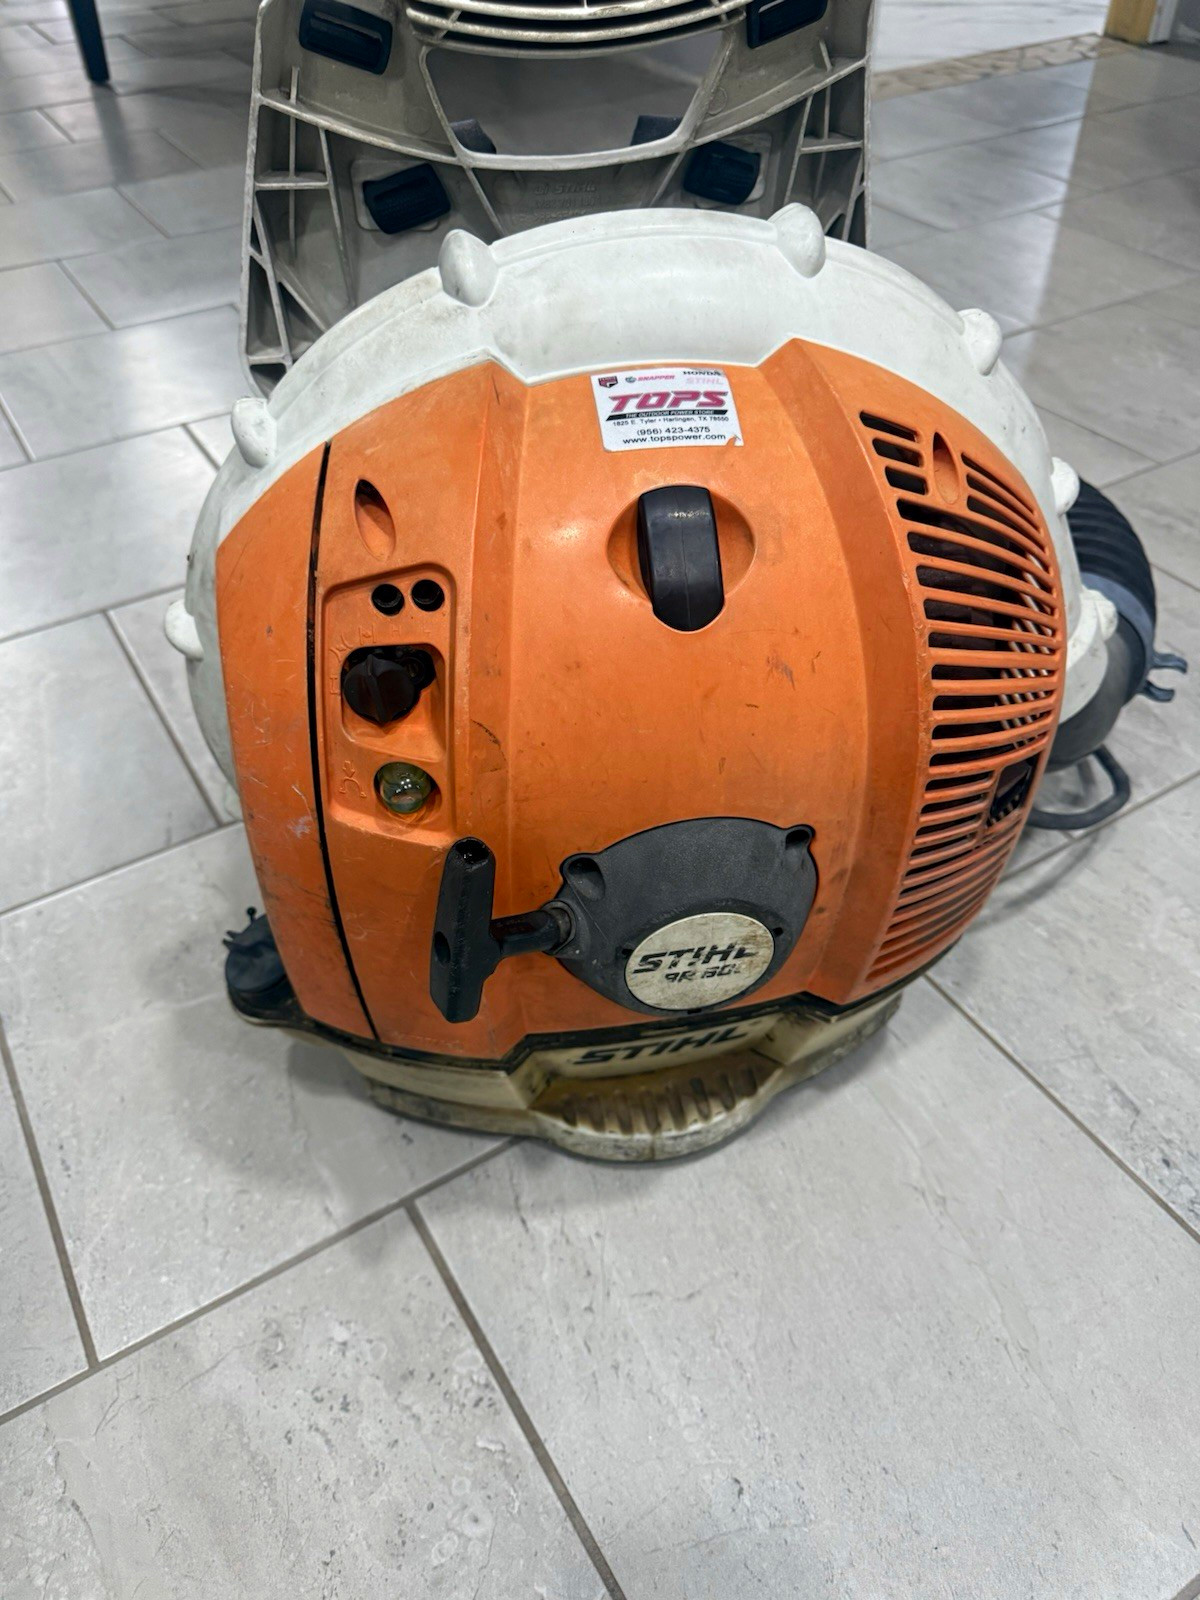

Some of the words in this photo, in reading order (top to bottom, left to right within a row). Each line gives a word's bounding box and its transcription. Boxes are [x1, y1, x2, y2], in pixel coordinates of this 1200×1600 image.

[609, 390, 729, 413] TOPS
[623, 434, 726, 444] www.topspower.com
[636, 428, 662, 436] (956)
[665, 426, 711, 434] 423-4375
[632, 943, 759, 974] STIHL
[573, 1026, 748, 1065] STIHL
